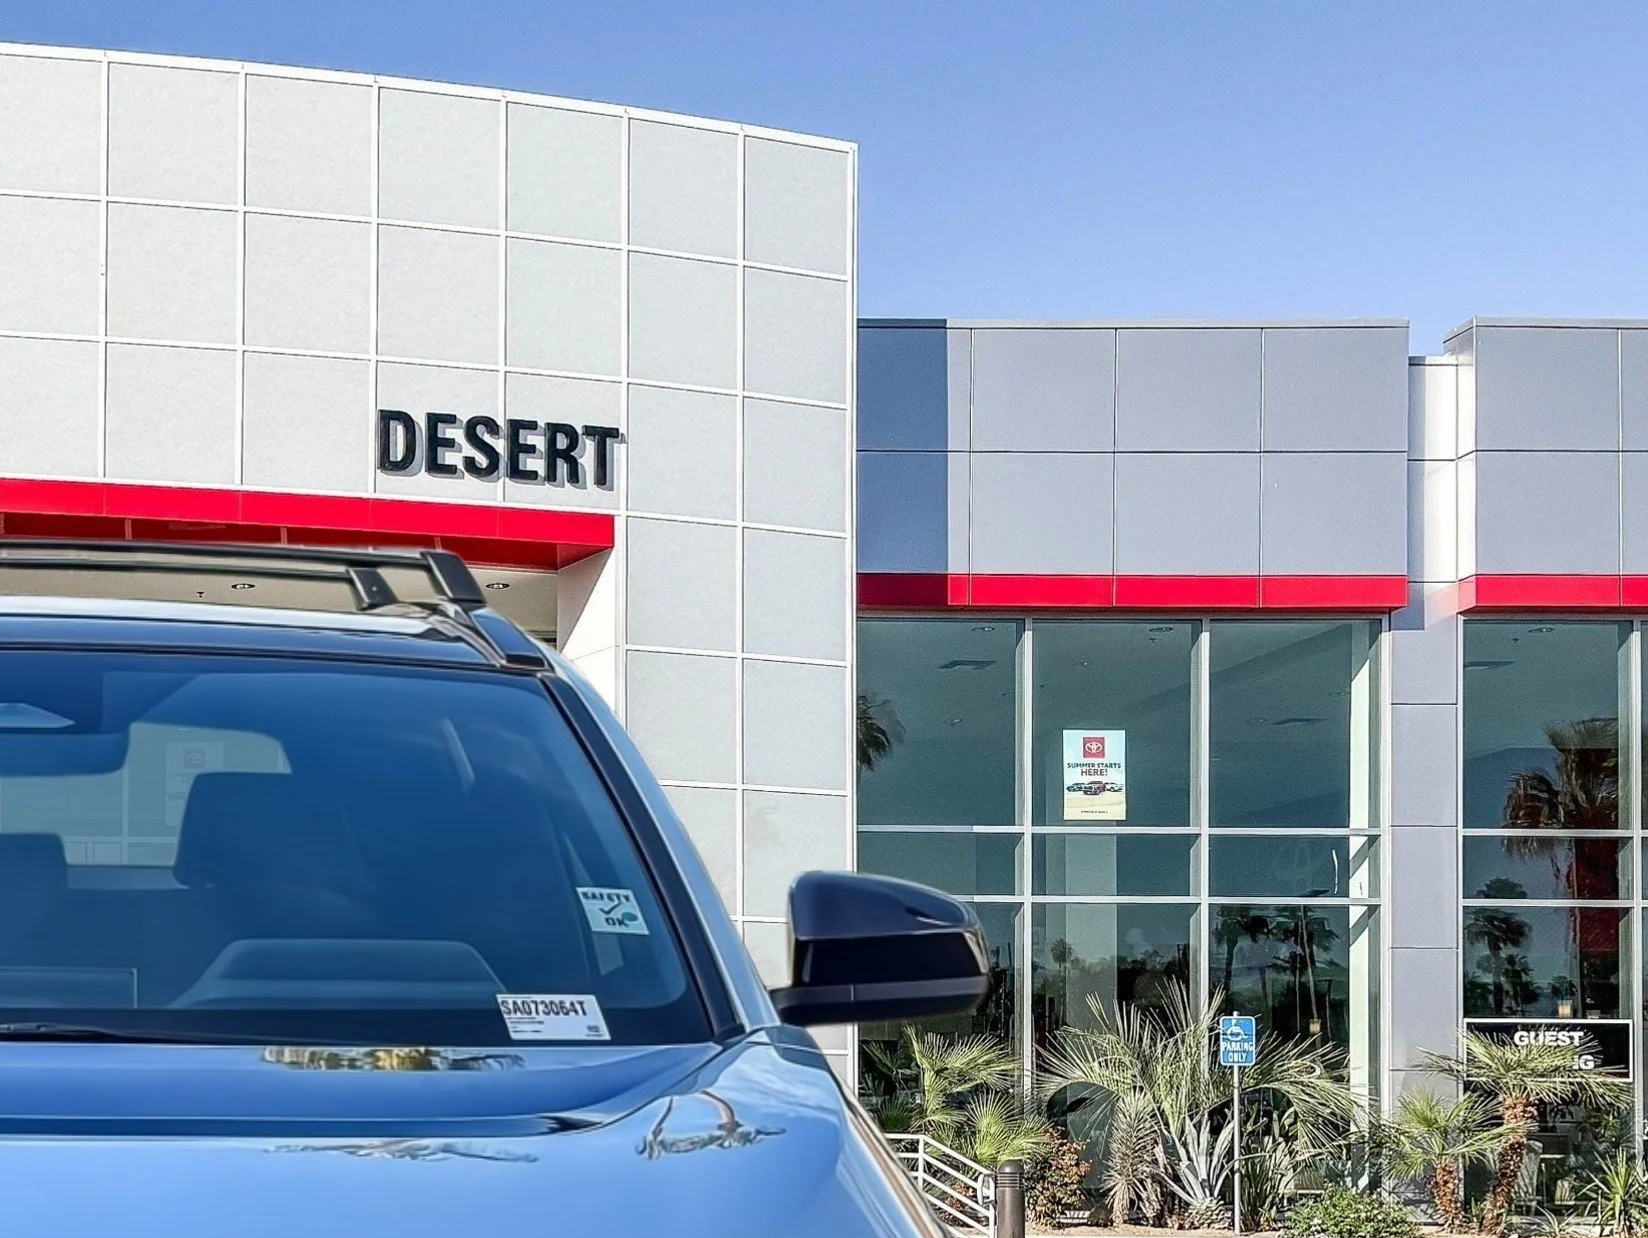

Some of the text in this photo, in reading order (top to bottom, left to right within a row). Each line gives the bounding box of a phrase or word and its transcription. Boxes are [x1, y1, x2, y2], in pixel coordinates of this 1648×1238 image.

[377, 409, 620, 486] DESERT
[1514, 1031, 1584, 1046] GUEST
[1222, 1041, 1253, 1051] PARKING
[1228, 1052, 1247, 1062] ONLY
